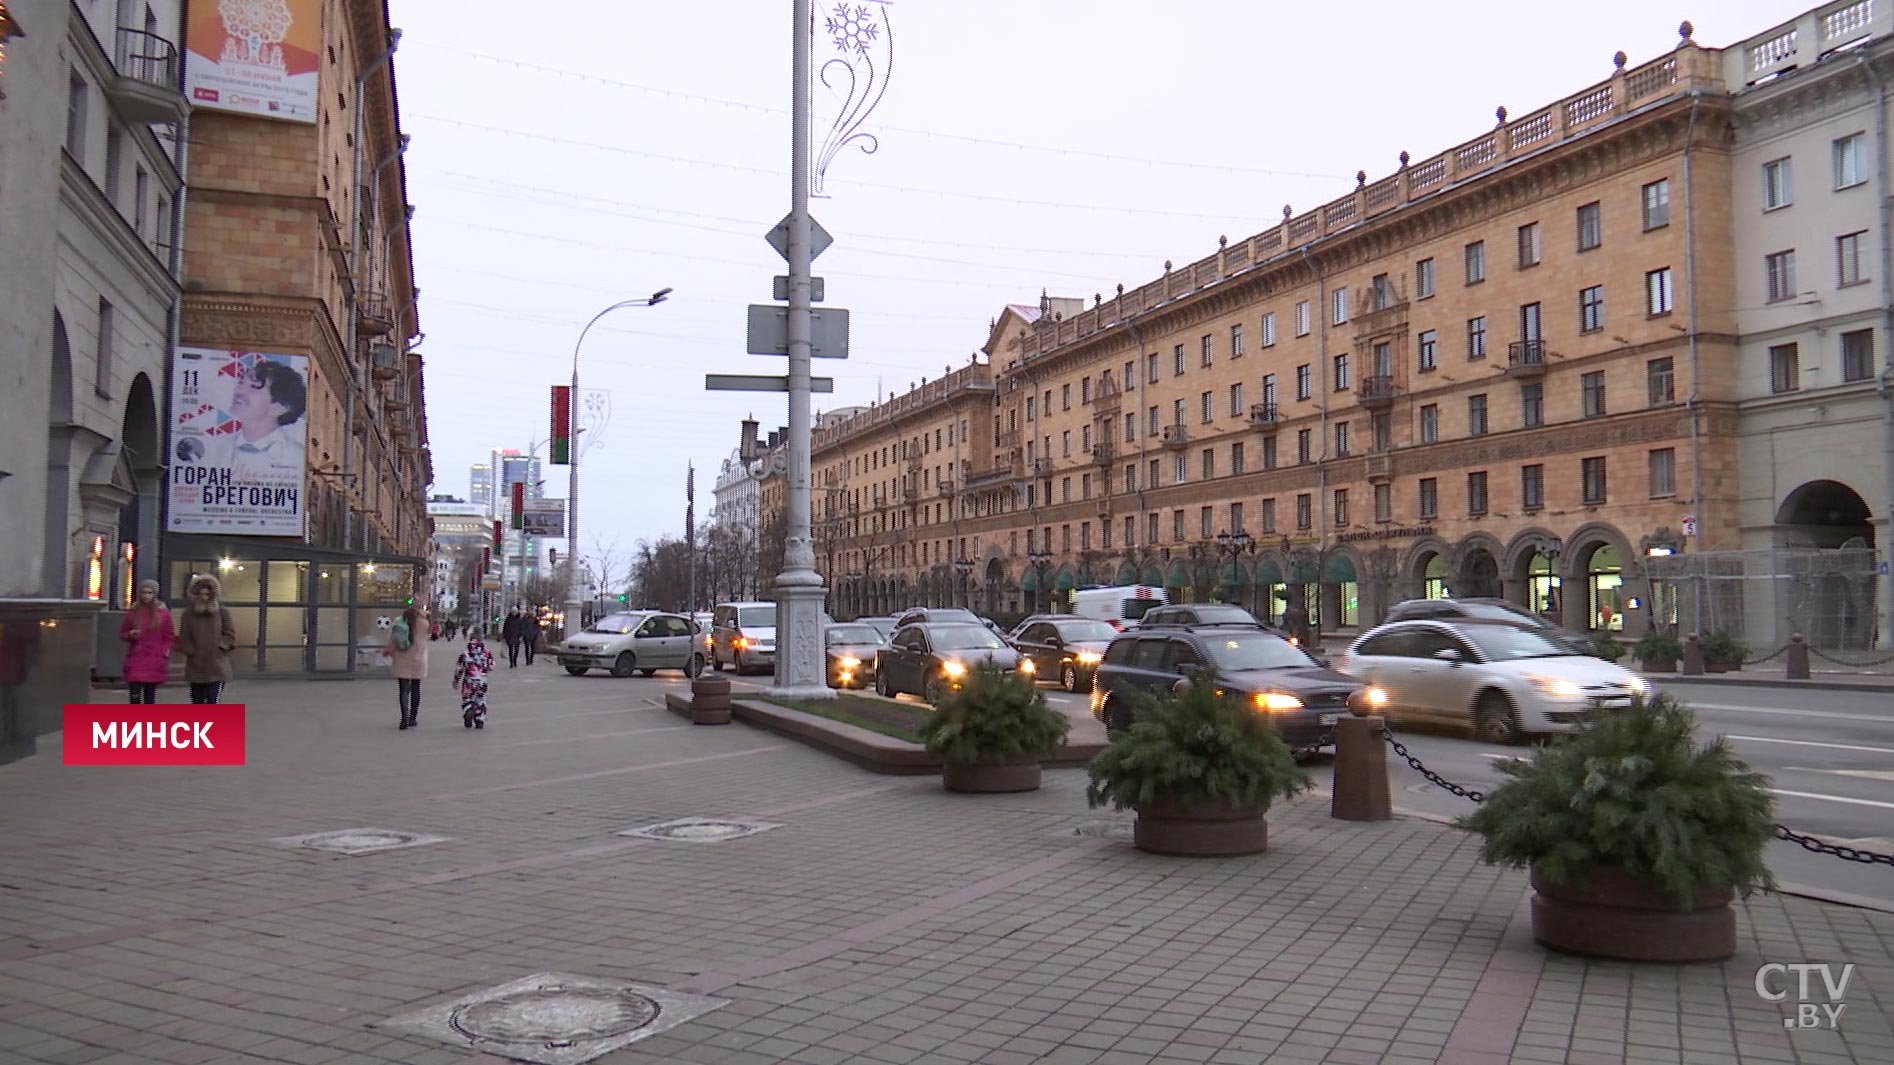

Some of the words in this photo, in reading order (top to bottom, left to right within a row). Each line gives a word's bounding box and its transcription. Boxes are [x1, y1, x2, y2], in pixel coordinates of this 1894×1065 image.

[184, 369, 198, 386] 11
[174, 466, 231, 485] ГОРАН
[202, 485, 298, 514] БРЕГОВИЧ
